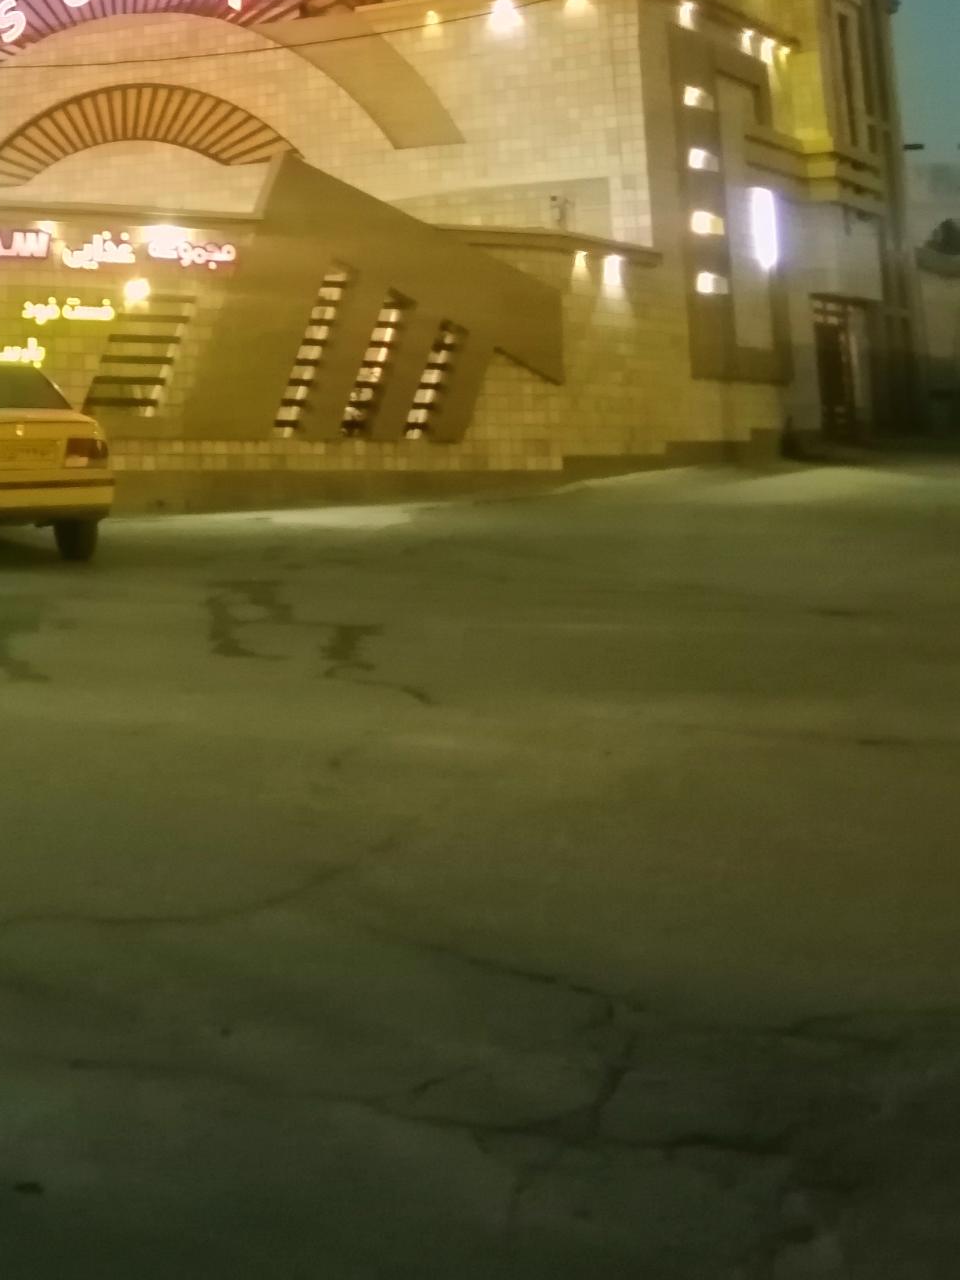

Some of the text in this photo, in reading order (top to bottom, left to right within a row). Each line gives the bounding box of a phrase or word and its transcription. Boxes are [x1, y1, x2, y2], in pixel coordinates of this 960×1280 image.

[62, 230, 136, 270] غذایی
[147, 239, 237, 270] مجموعه
[22, 296, 115, 325] فست فود
